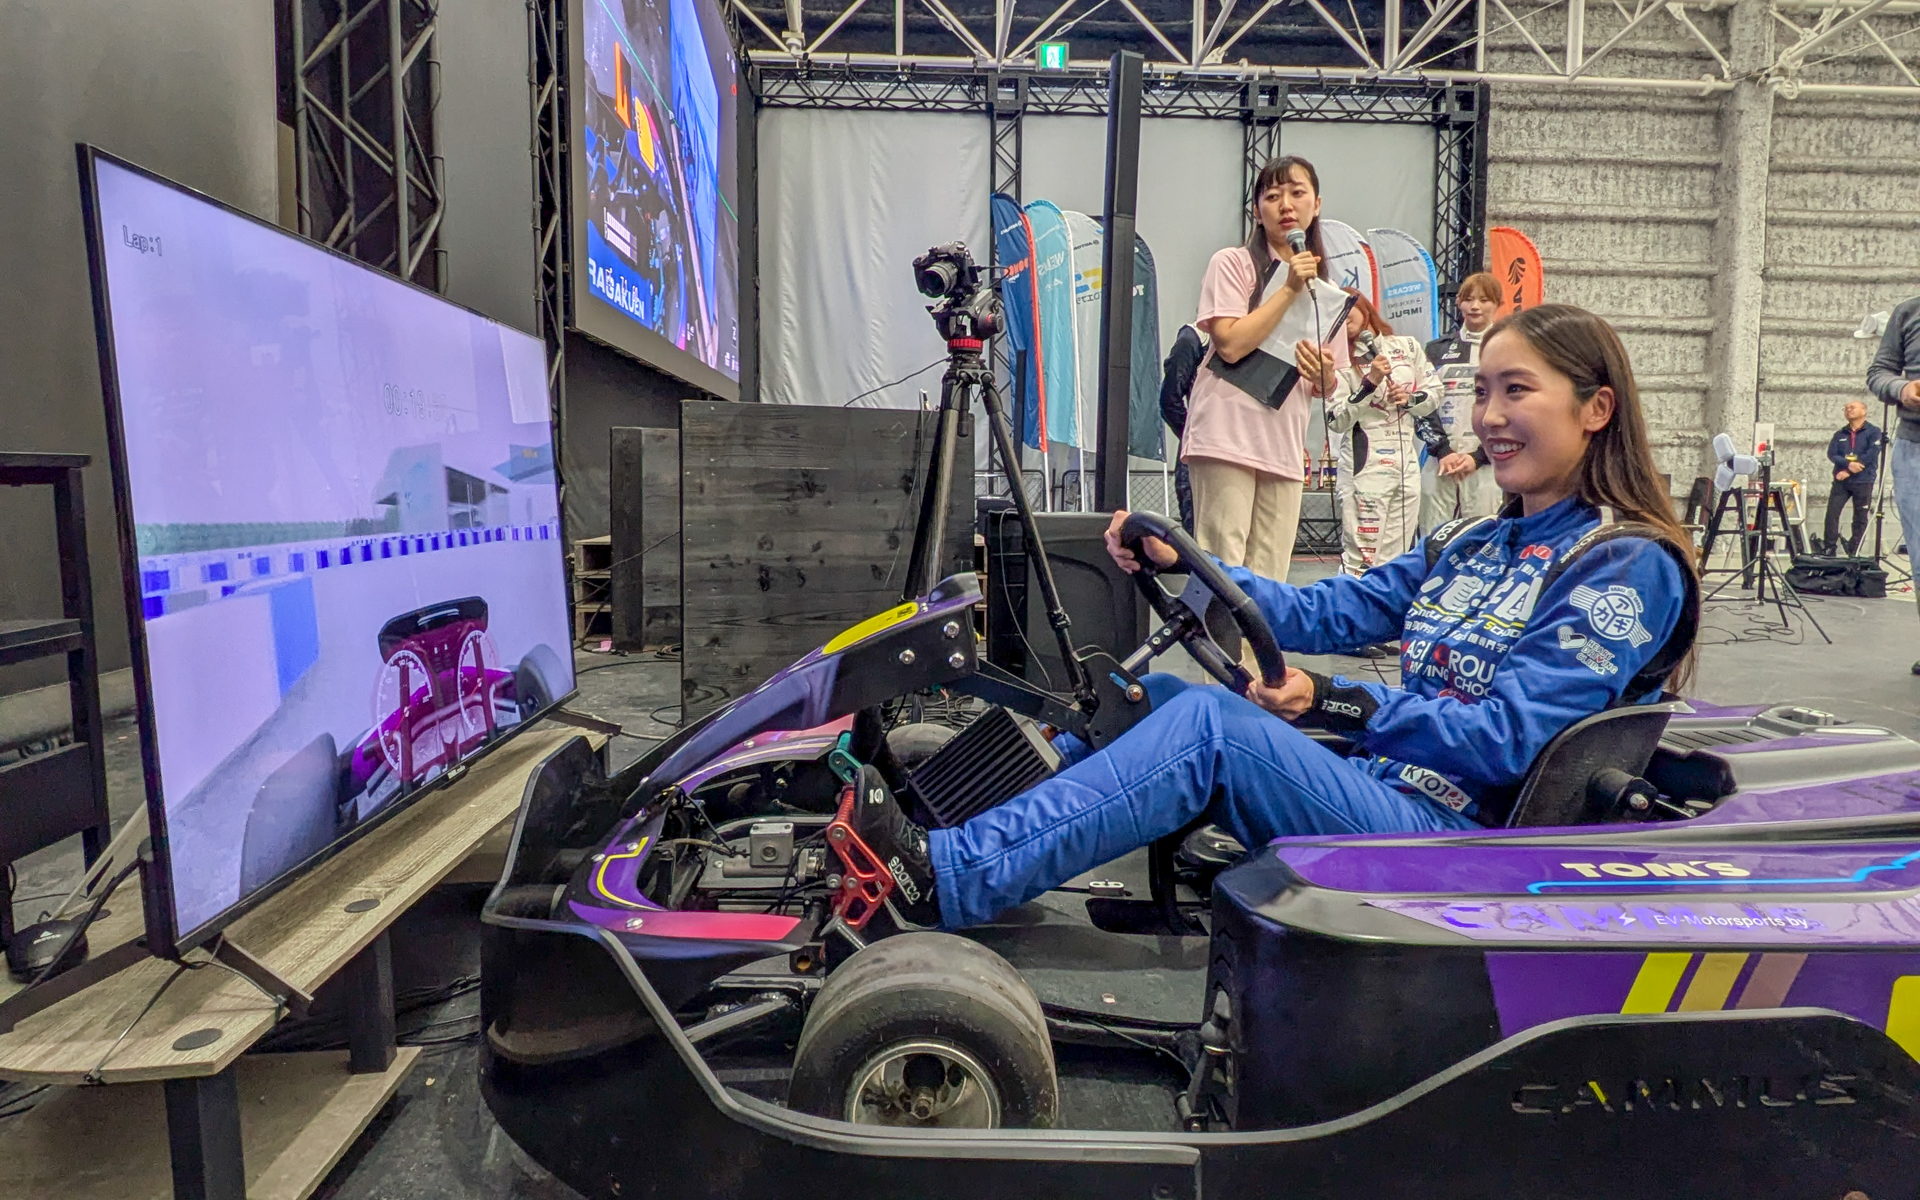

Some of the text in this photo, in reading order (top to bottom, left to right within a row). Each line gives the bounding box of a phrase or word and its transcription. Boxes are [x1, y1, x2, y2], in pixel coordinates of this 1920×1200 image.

[1587, 640, 1615, 661] HEART
[868, 788, 884, 804] 10
[1654, 912, 1808, 930] EV-Motorsports by
